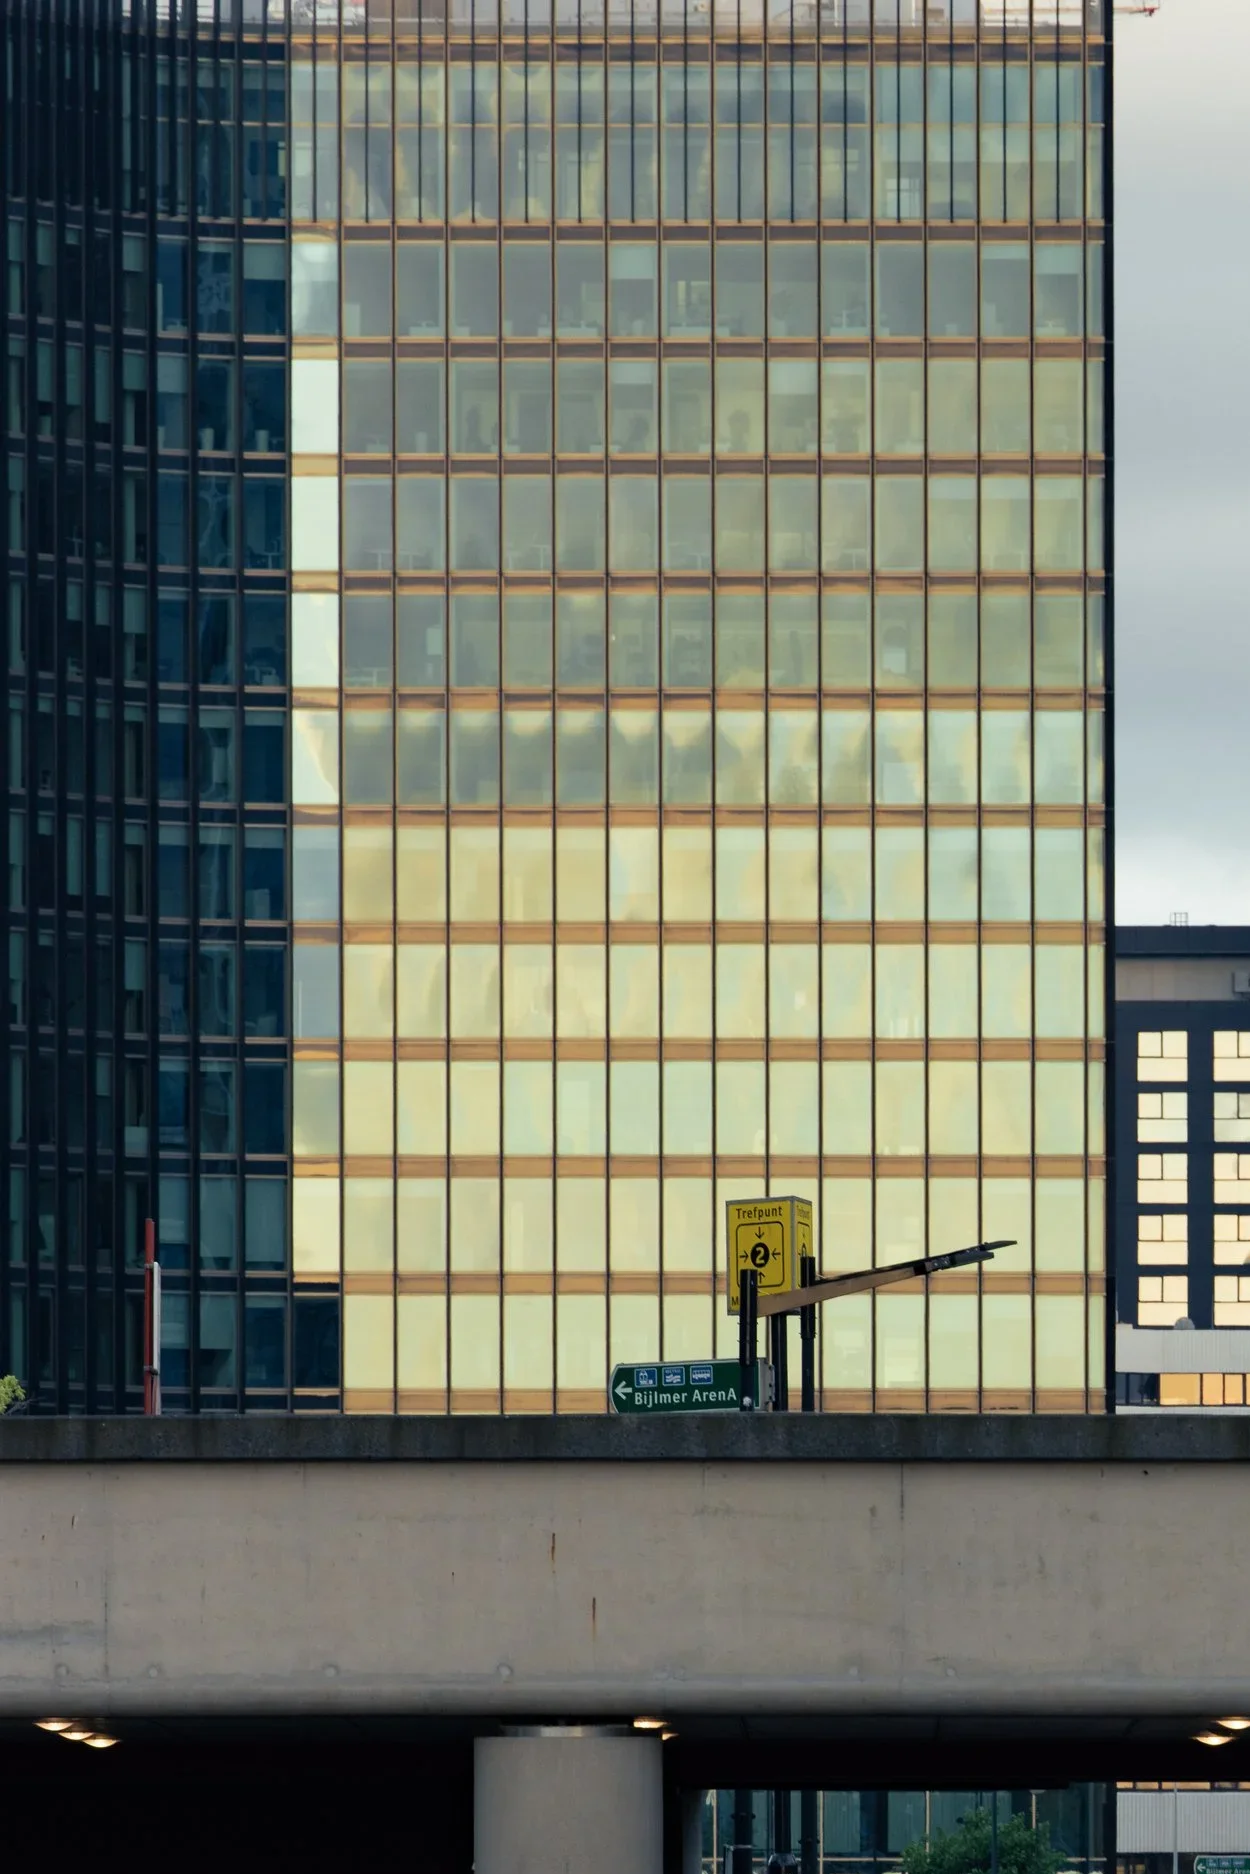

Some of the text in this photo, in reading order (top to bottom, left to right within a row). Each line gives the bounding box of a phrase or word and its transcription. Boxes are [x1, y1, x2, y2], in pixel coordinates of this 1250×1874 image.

[736, 1206, 783, 1220] Trefpunt
[756, 1247, 765, 1264] 2
[634, 1388, 737, 1408] Bijlmer ArenA
